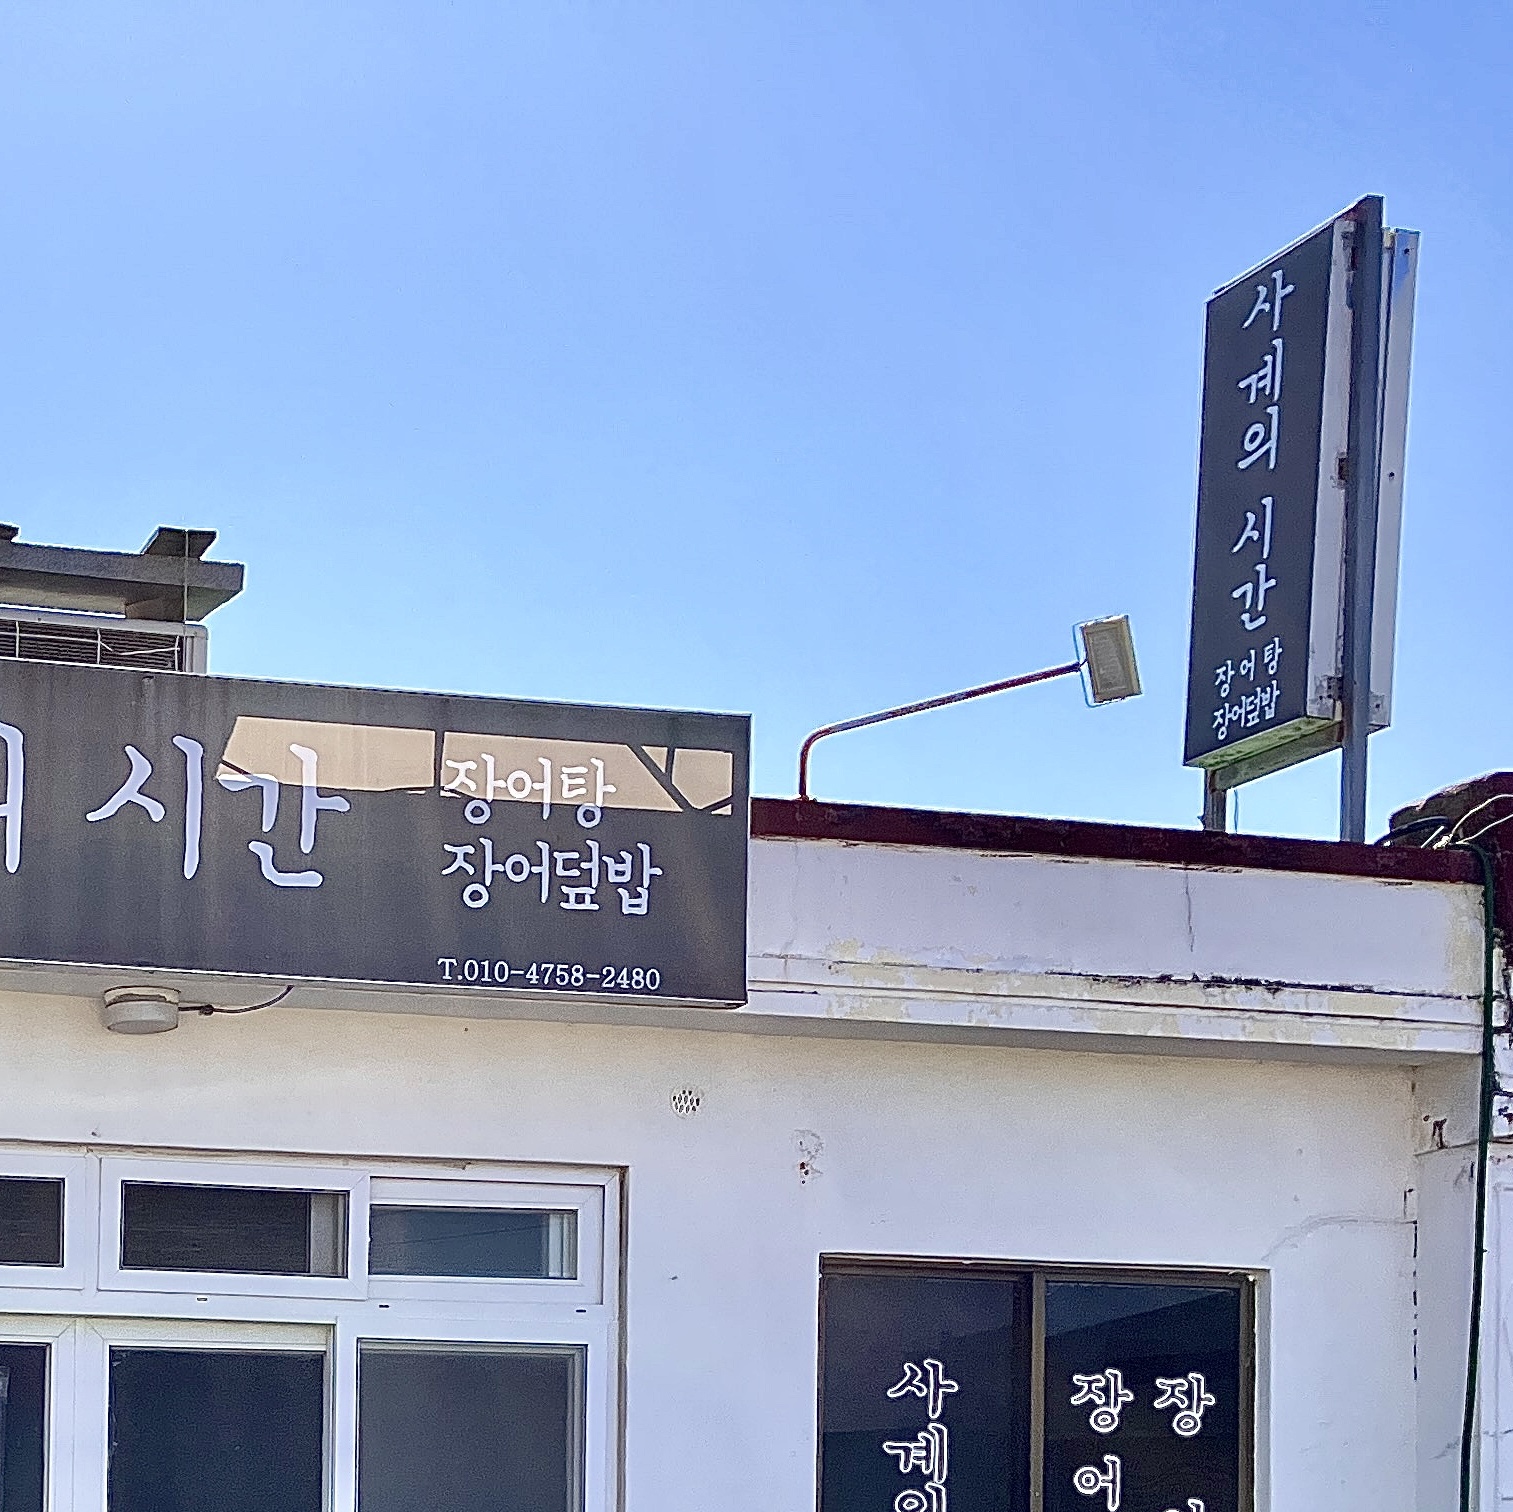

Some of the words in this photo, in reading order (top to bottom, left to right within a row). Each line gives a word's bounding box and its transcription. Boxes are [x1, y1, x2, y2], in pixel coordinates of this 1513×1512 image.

[1237, 268, 1296, 472] 사계의
[1231, 496, 1277, 632] 시간
[1214, 636, 1284, 699] 장어탕
[1212, 685, 1281, 741] 장어덮밥
[86, 735, 350, 887] 시간
[441, 753, 616, 828] 장어탕
[441, 837, 662, 915] 장어덮밥
[438, 956, 661, 991] T.010-4758-2480
